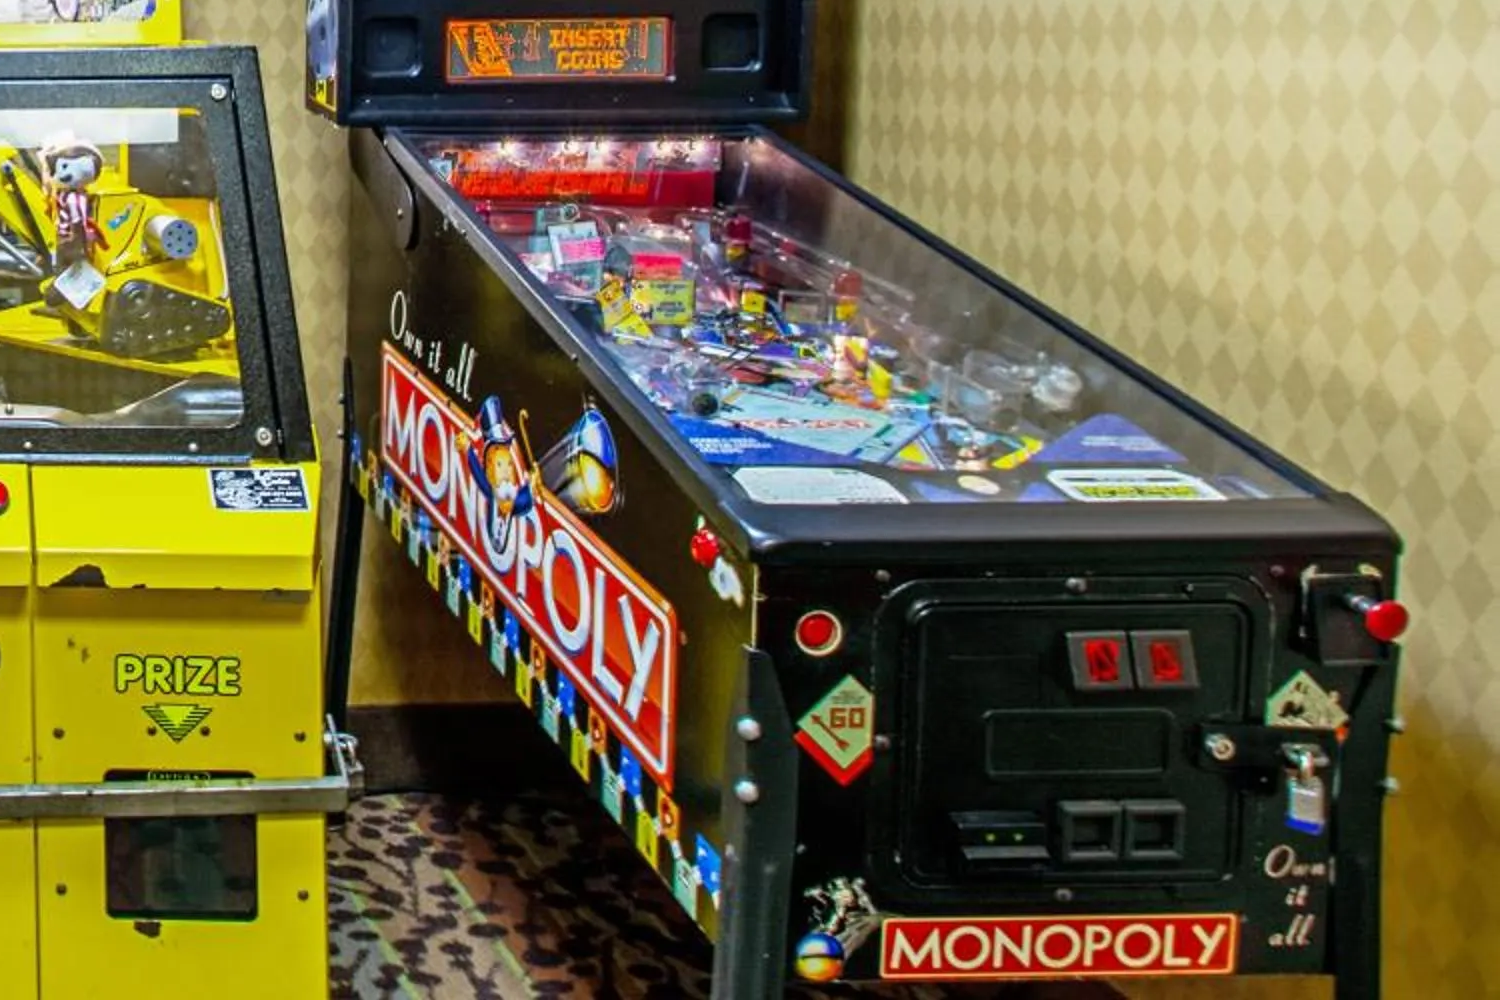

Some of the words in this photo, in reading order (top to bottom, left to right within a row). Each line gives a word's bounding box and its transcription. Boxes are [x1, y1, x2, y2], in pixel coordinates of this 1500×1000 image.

[548, 28, 628, 49] INSERT
[556, 49, 626, 71] COINS
[389, 288, 423, 359] Own
[427, 340, 442, 374] it
[444, 342, 479, 403] all
[386, 377, 661, 722] MONOPOLY
[115, 653, 242, 697] PRIZE
[829, 707, 866, 729] GO
[1263, 844, 1327, 879] Own
[1285, 884, 1309, 907] it
[889, 923, 1228, 970] MONOPOLY
[1267, 913, 1316, 948] all
